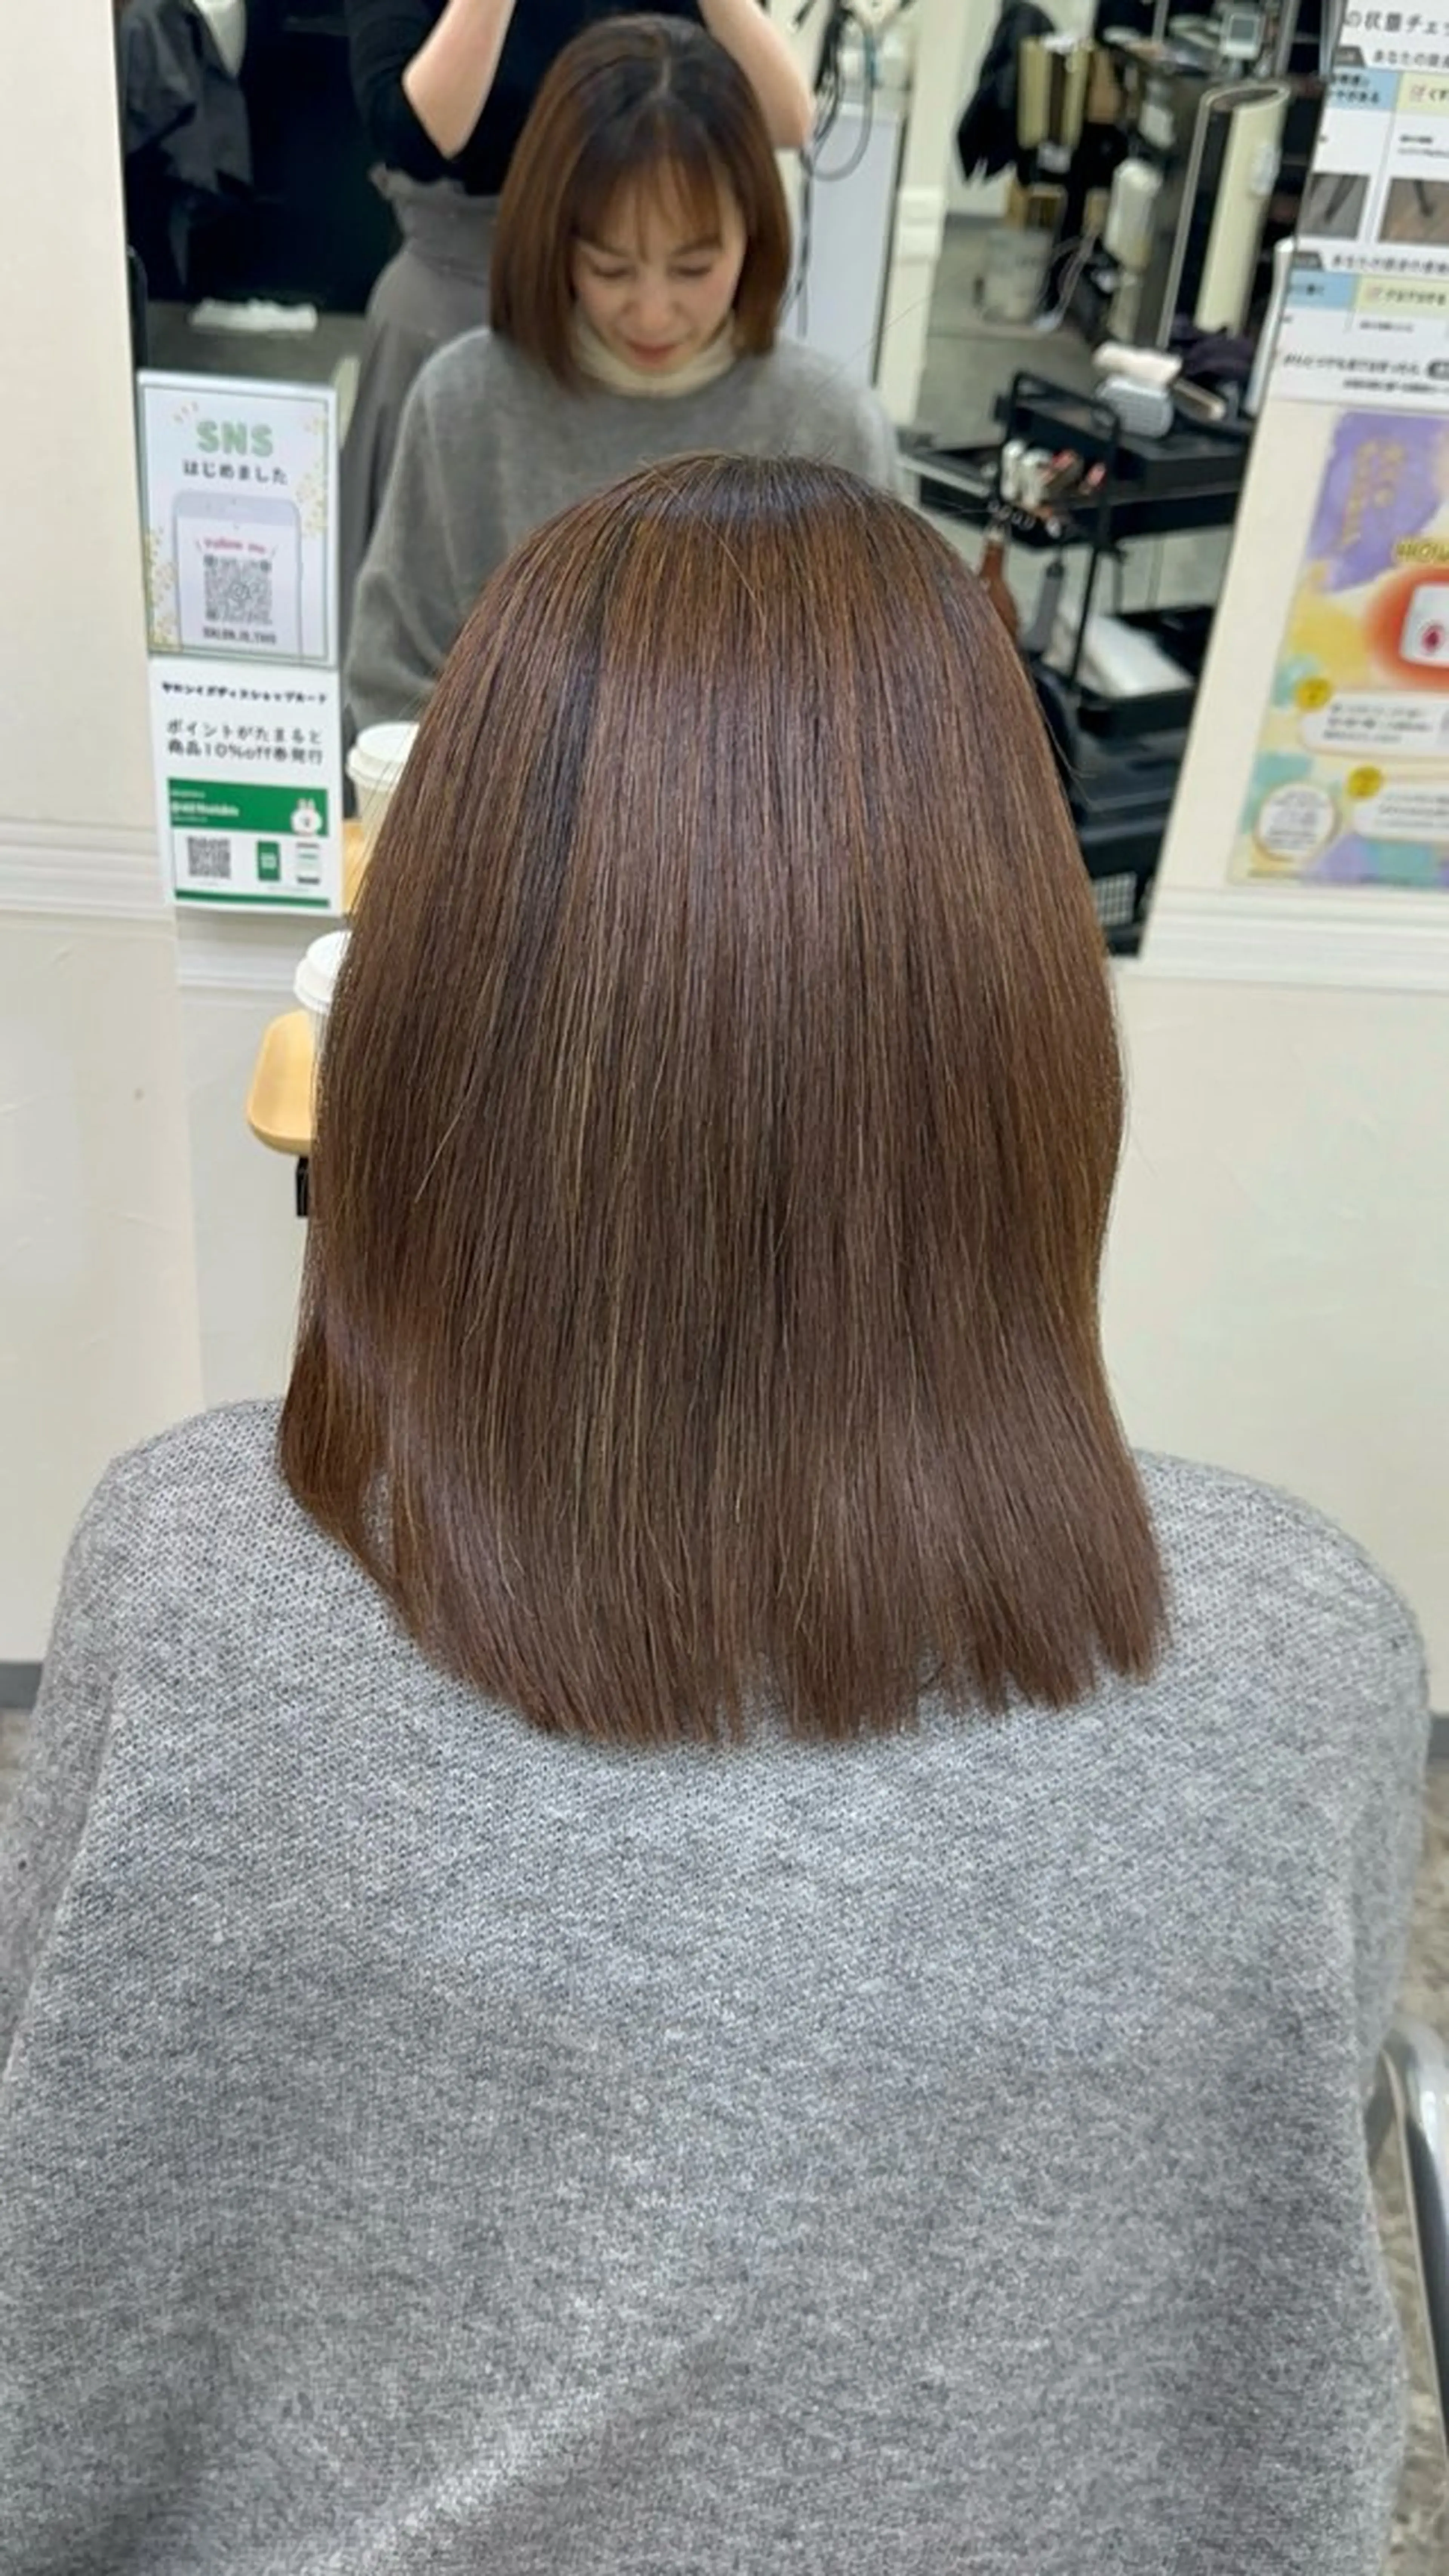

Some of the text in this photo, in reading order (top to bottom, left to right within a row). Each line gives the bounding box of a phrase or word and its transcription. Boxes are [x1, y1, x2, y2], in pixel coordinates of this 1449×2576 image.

[196, 420, 273, 458] SNS
[183, 460, 288, 485] はじめました
[167, 718, 323, 744] ポイントがたまると
